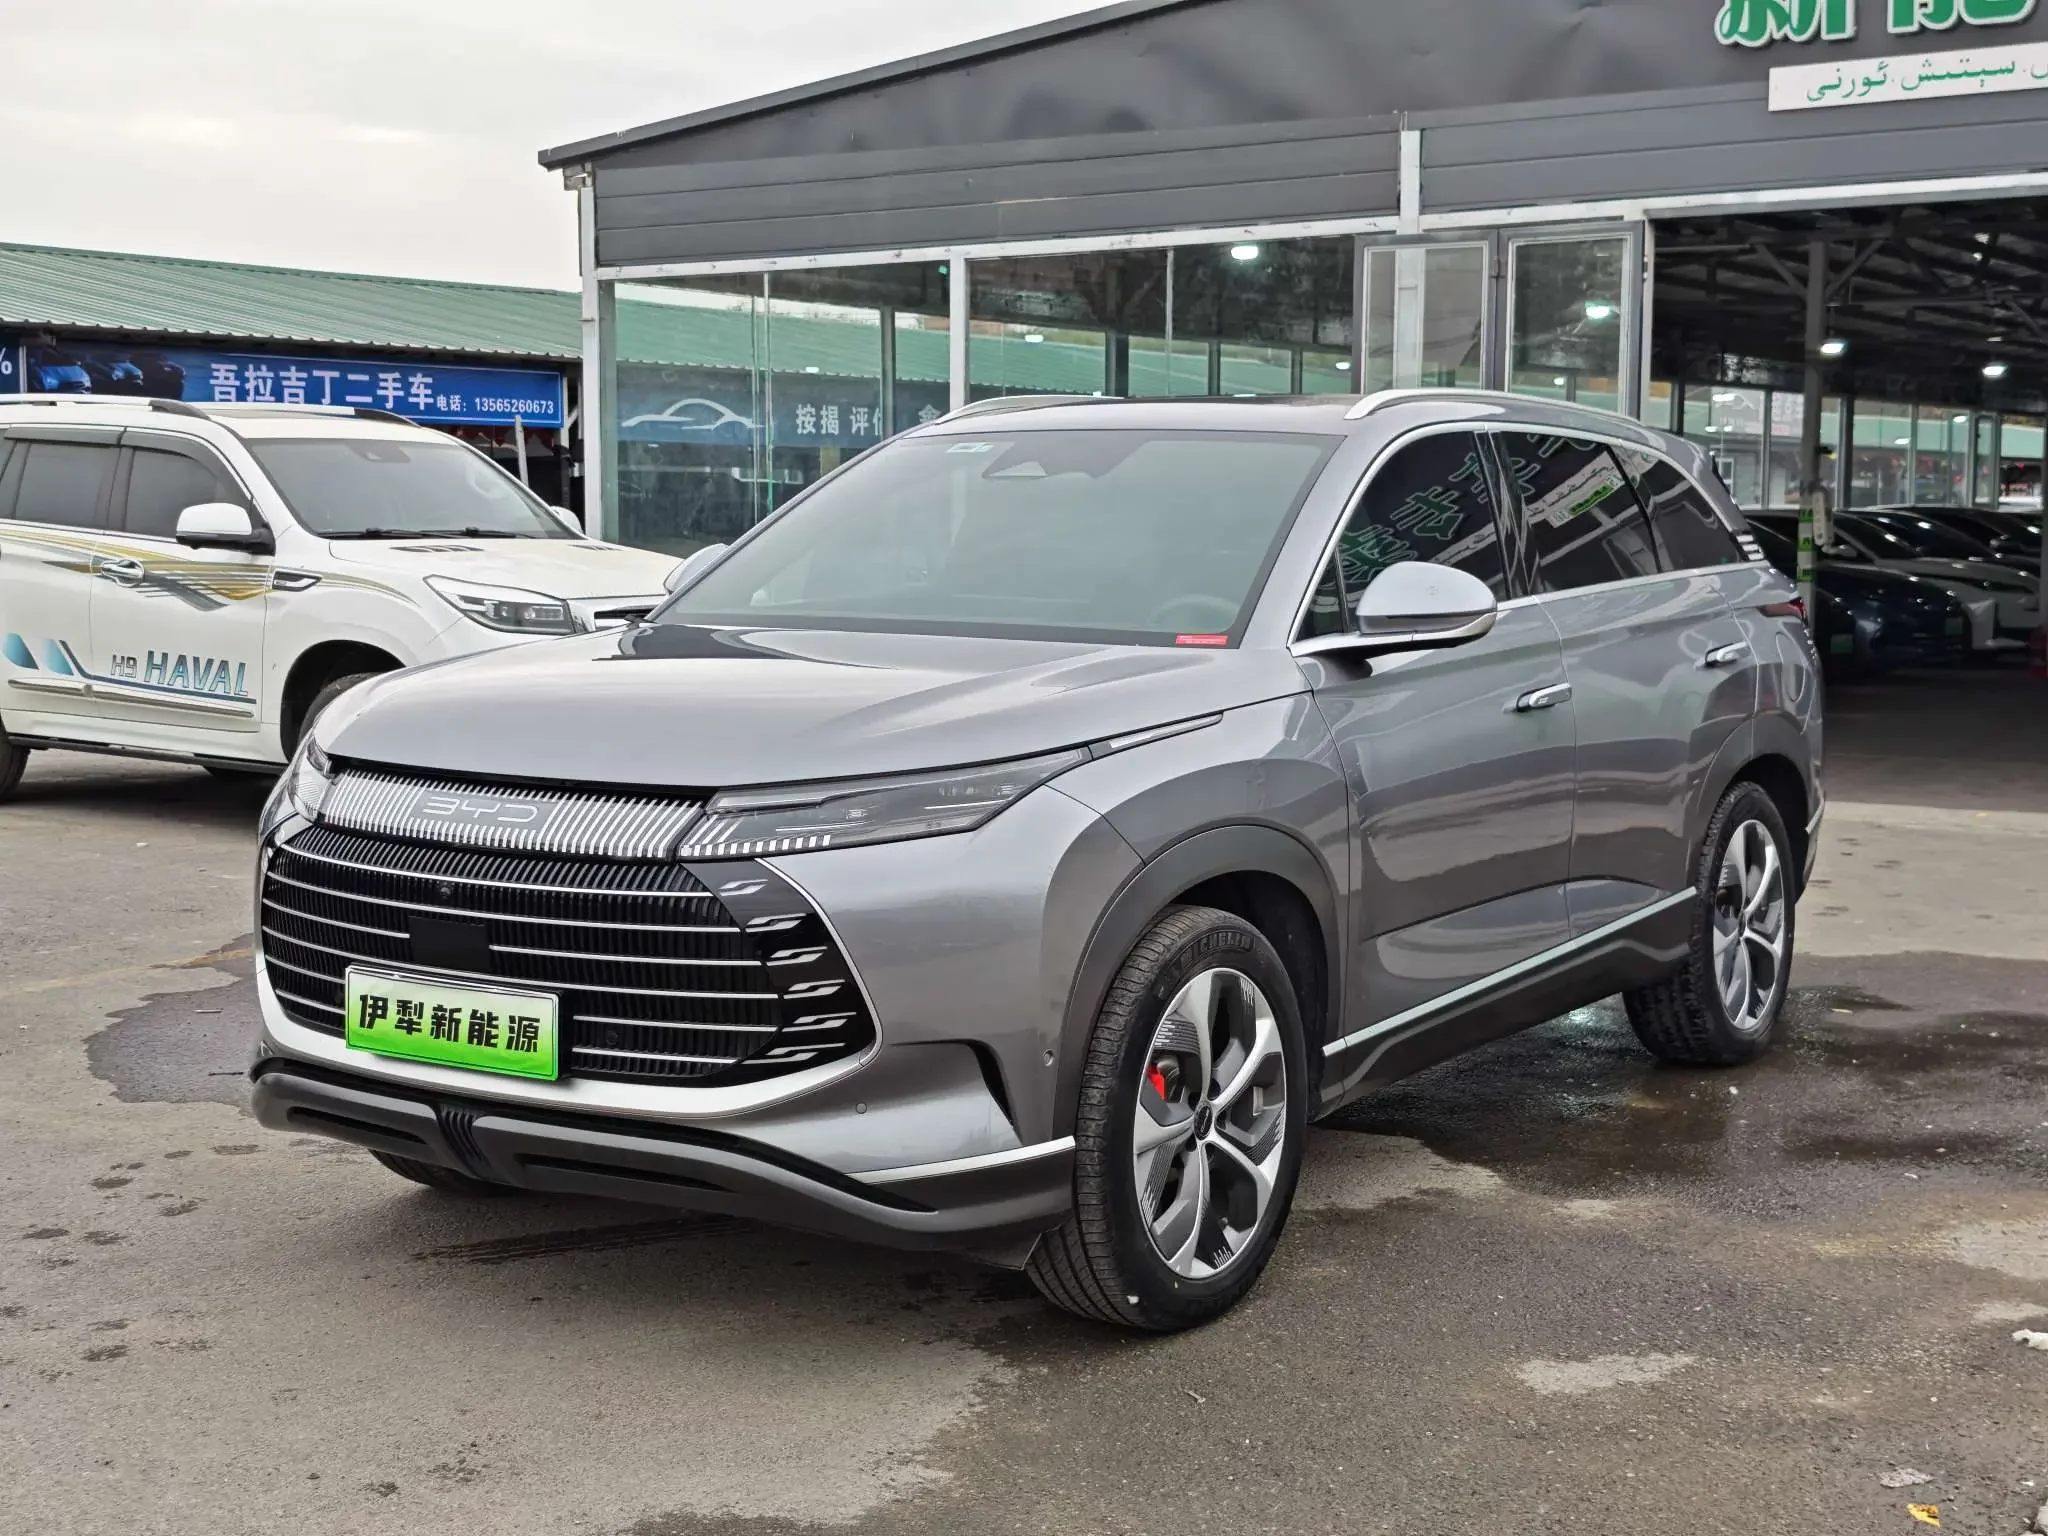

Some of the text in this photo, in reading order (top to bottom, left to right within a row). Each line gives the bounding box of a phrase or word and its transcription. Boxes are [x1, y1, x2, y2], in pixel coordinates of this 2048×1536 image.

[209, 362, 434, 411] 吾拉吉丁二手车
[475, 397, 554, 415] 13565260673
[795, 403, 840, 436] 按揭
[110, 650, 249, 696] H9 HAVAL
[422, 795, 539, 823] BYD
[358, 993, 541, 1053] 伊犁新能源
